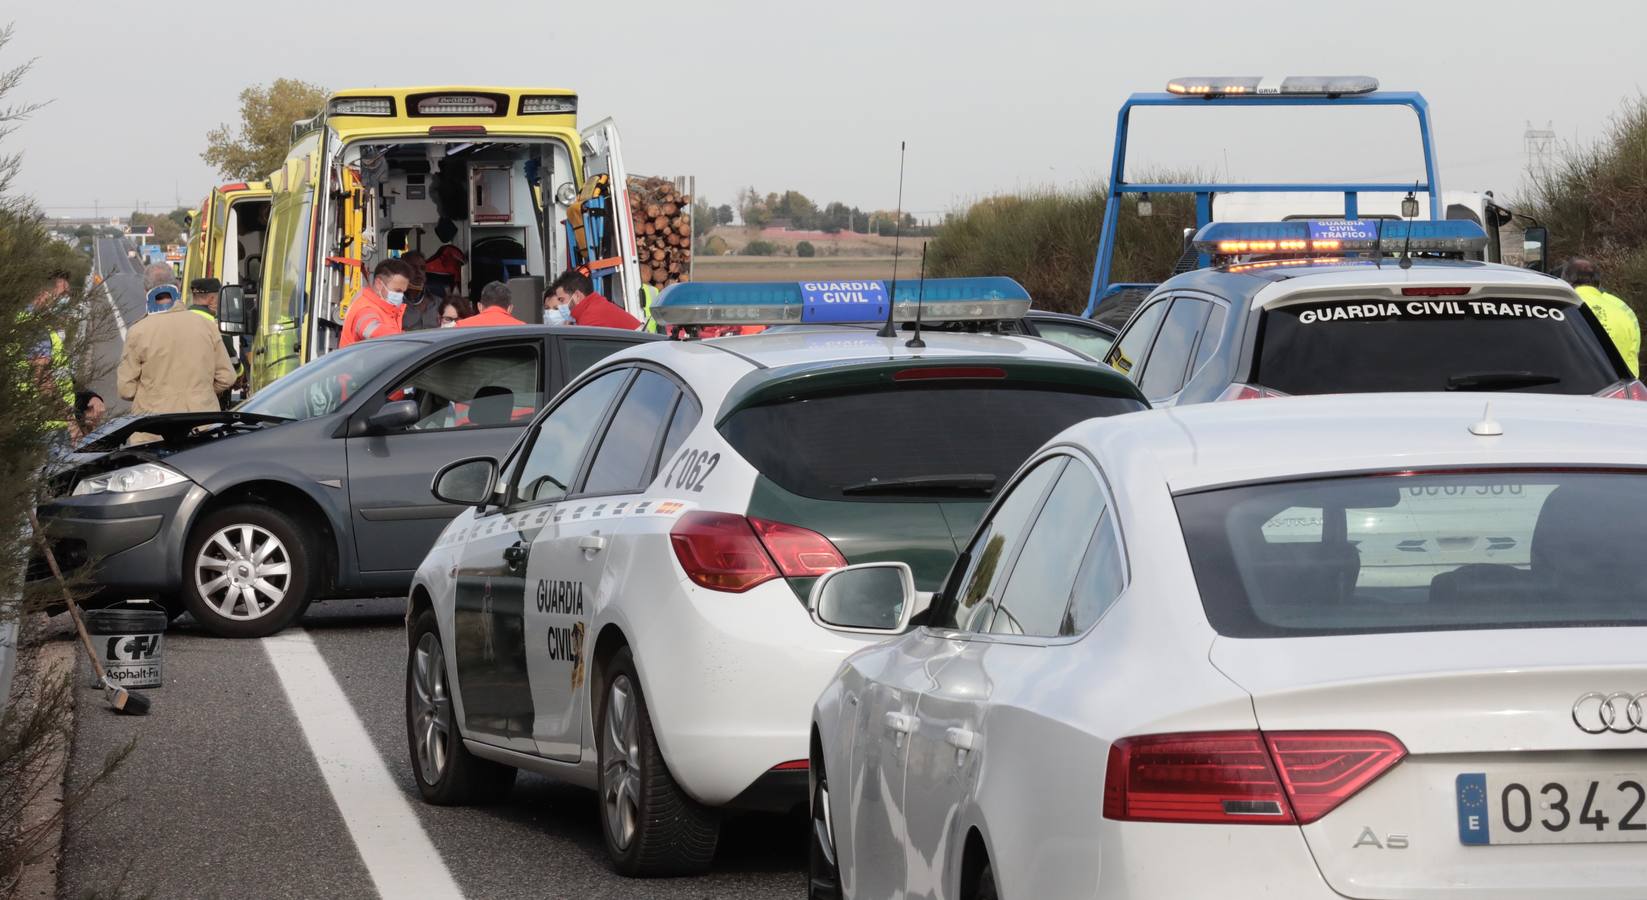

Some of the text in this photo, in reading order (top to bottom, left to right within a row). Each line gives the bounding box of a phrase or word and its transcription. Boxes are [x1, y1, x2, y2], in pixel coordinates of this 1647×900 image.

[803, 282, 881, 291] GUARDIA
[823, 292, 869, 303] CIVIL
[1299, 301, 1565, 324] GUARDIA CIVIL TRAFICO
[536, 579, 584, 615] GUARDIA
[547, 625, 579, 662] CIVIL
[1501, 781, 1647, 832] 0342
[1468, 815, 1480, 830] E
[1352, 825, 1409, 850] A5
